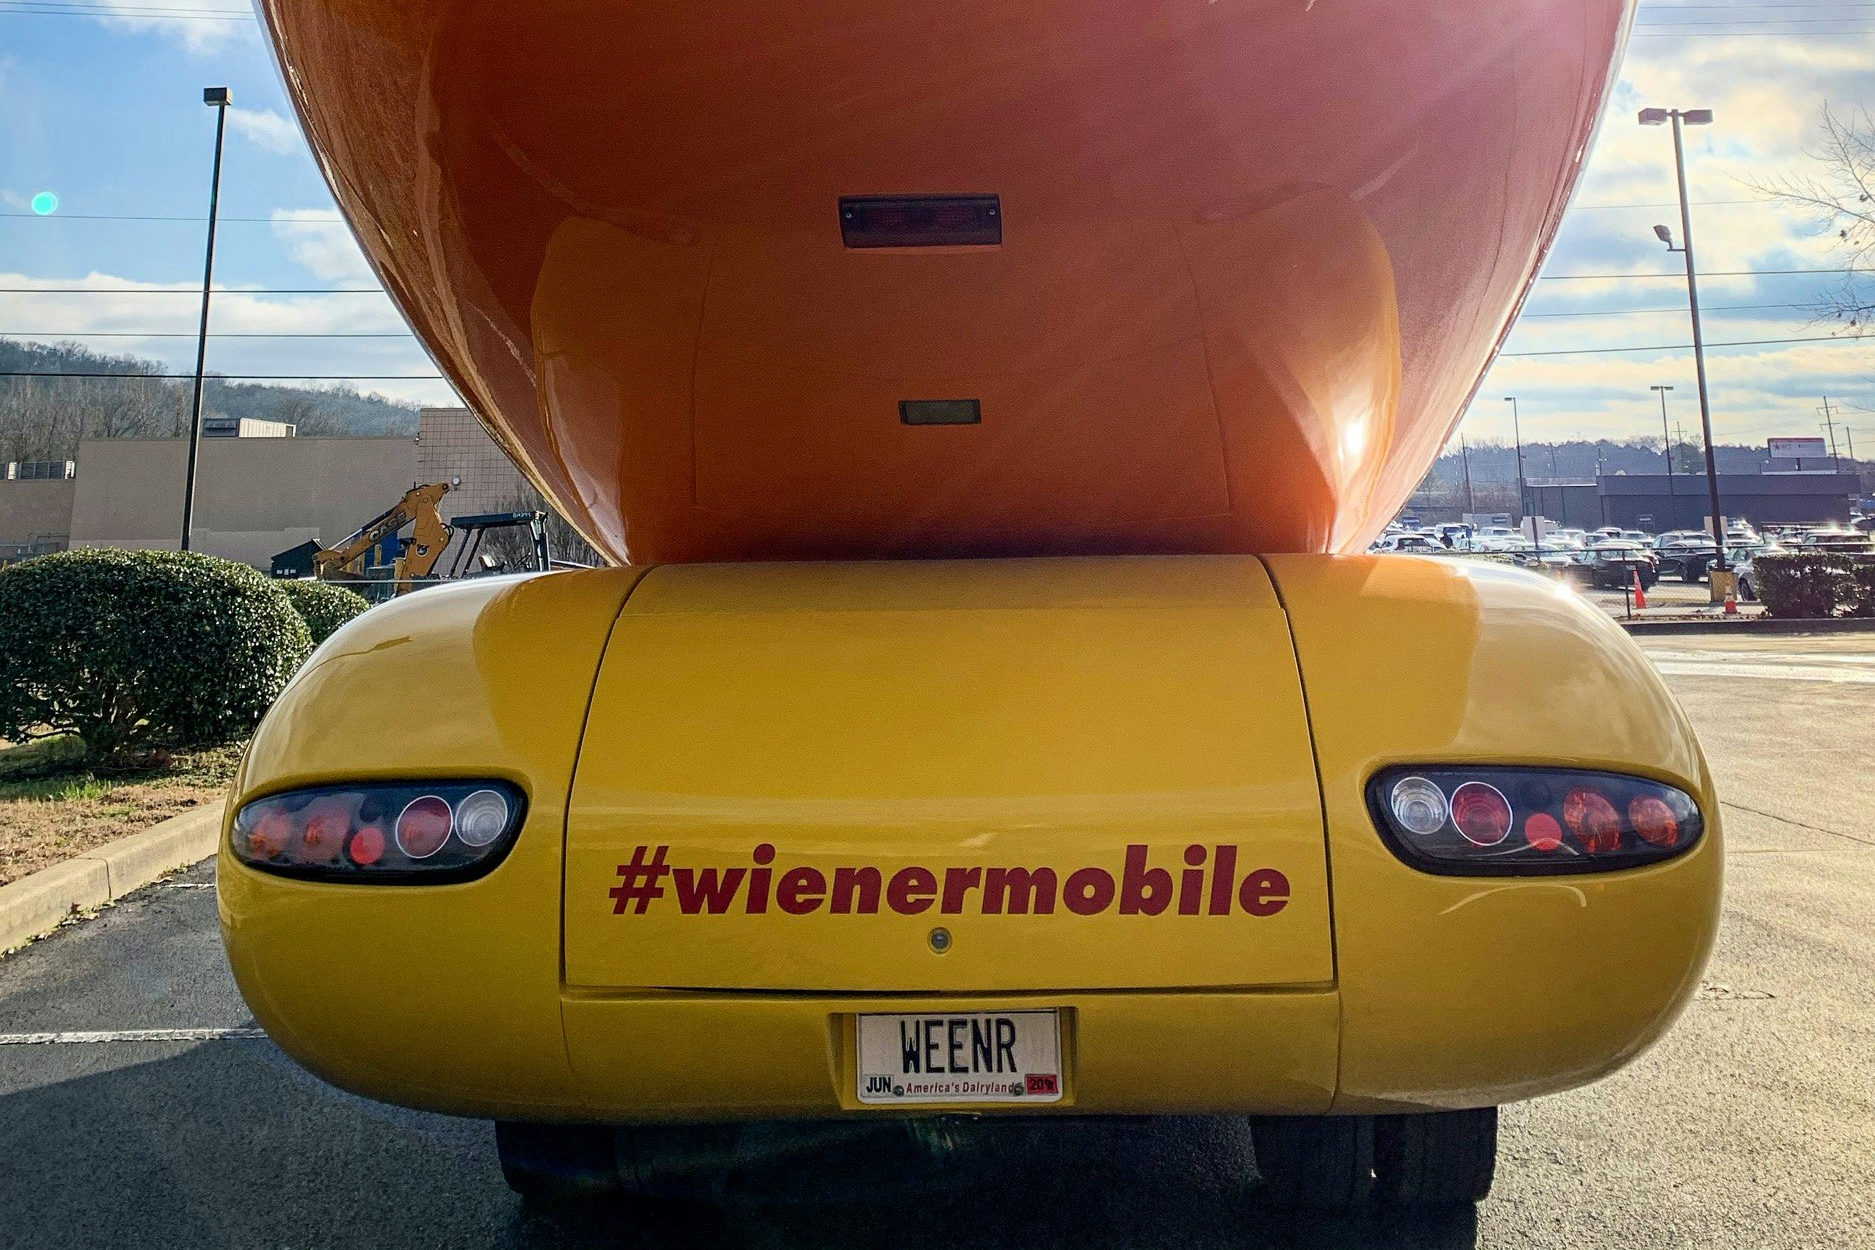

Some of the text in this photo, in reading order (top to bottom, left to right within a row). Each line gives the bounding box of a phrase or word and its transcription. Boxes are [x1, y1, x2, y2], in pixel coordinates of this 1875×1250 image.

[609, 843, 1290, 917] #wienermobile
[901, 1018, 1018, 1073] WEENR
[866, 1077, 892, 1093] JUN
[906, 1082, 1015, 1095] America's Dairyland
